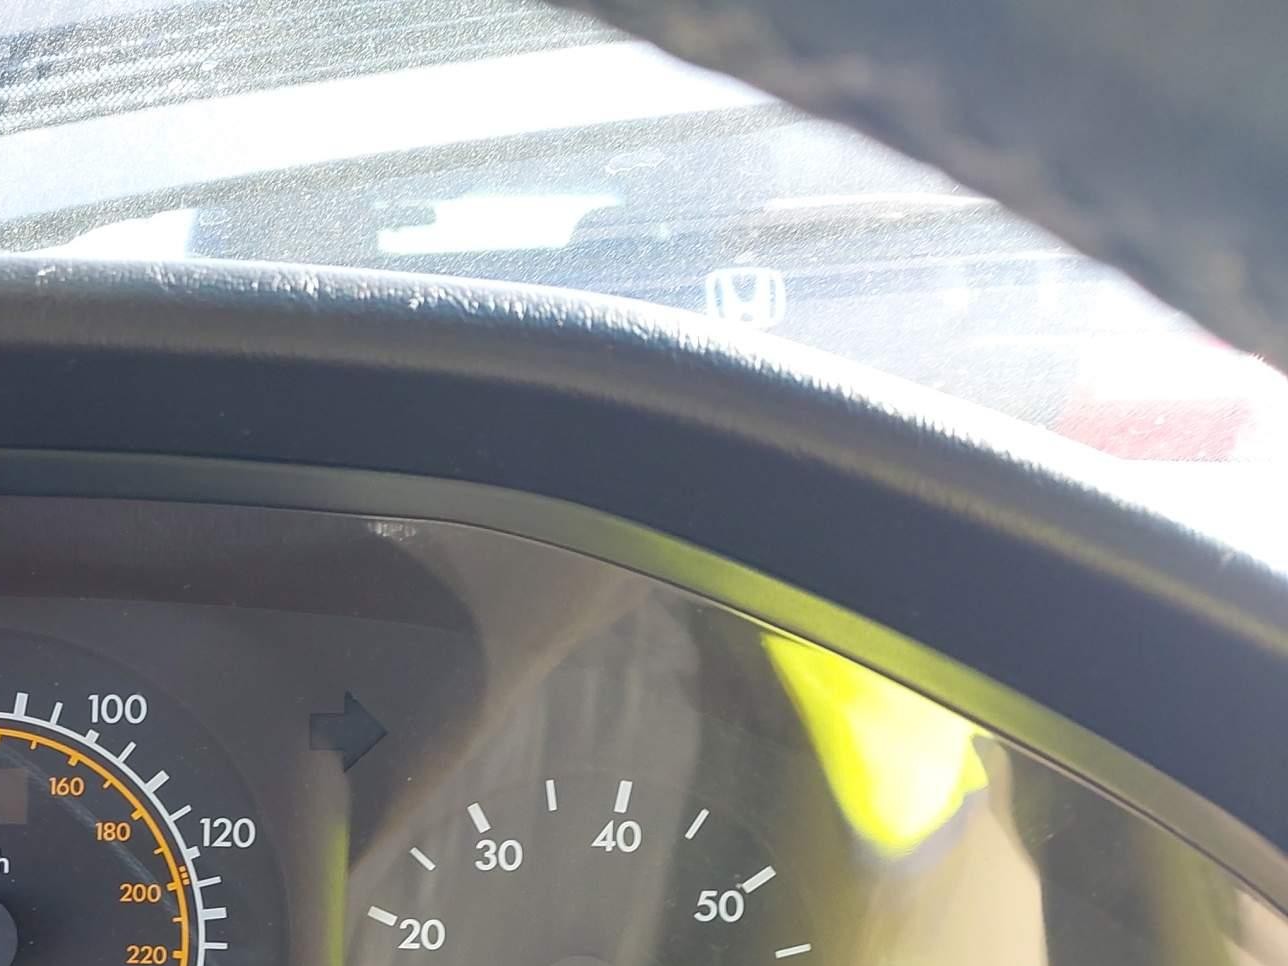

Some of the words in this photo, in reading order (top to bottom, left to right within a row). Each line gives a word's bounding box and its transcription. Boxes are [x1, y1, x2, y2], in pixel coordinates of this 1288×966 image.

[88, 693, 148, 724] 100
[49, 776, 85, 796] 160
[95, 822, 131, 841] 180
[200, 817, 256, 848] 120
[591, 820, 642, 853] 40
[475, 839, 523, 872] 30
[120, 884, 161, 902] 200
[693, 889, 745, 923] 50
[398, 917, 445, 950] 20
[126, 945, 167, 965] 220
